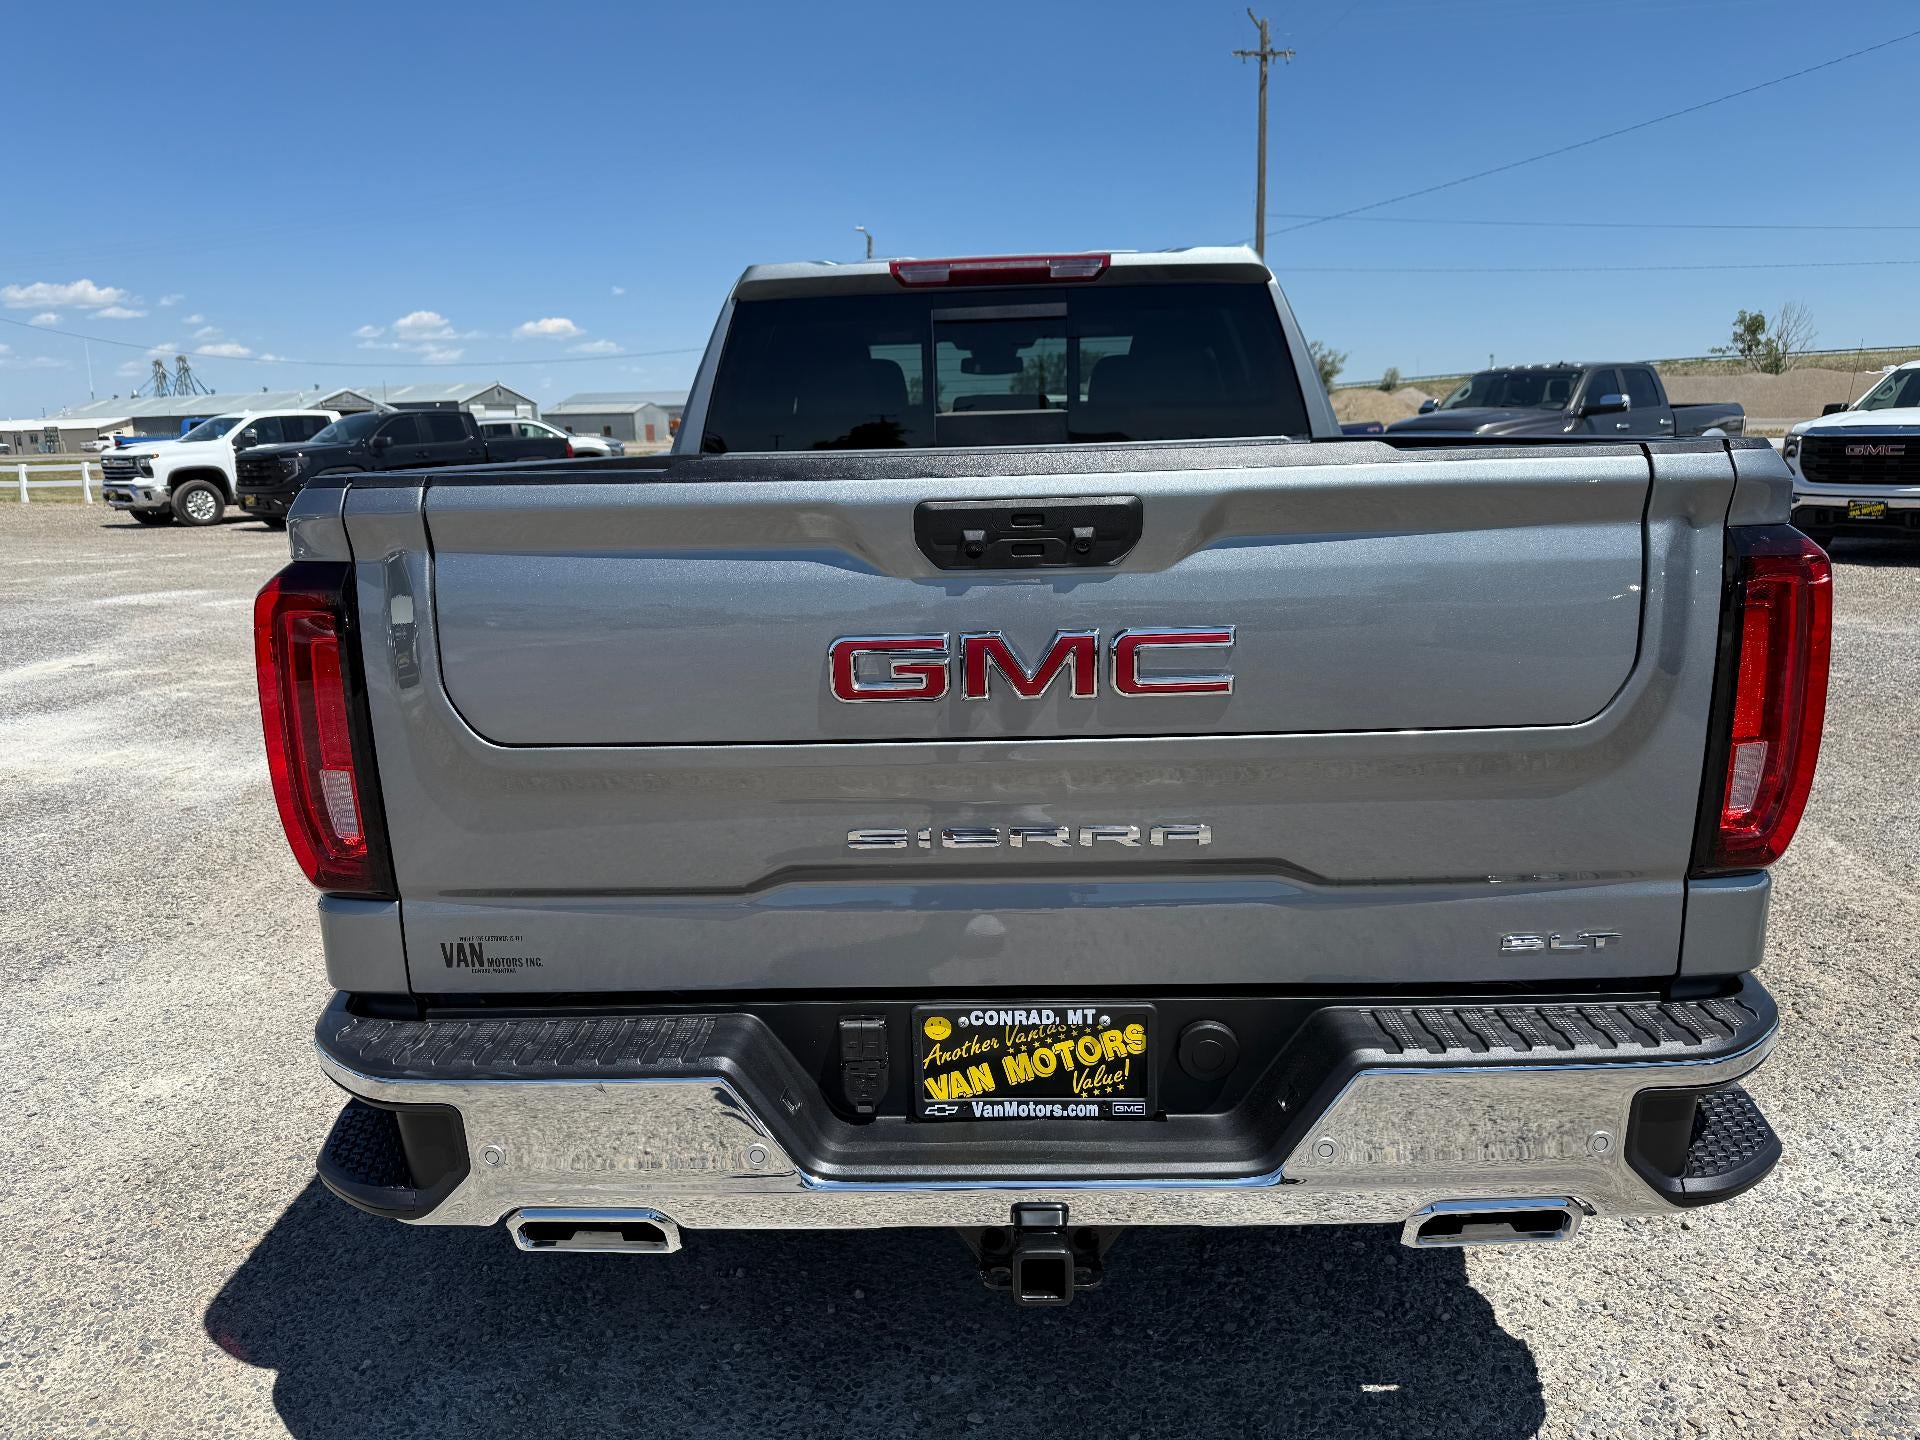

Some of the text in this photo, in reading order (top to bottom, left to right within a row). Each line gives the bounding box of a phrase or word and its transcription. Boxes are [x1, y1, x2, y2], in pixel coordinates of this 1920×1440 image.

[1846, 445, 1905, 455] GMC
[828, 625, 1237, 702] GMC
[847, 824, 1212, 849] SIERRA
[1500, 930, 1623, 951] SLT
[440, 942, 544, 968] VAN MOTORS INC.
[969, 1009, 1096, 1026] CONRAD, MT
[922, 1035, 1000, 1070] Another
[924, 1023, 1147, 1100] VAN MOTORS
[1073, 1058, 1130, 1094] Value!
[971, 1101, 1099, 1118] VanMotors.com
[1115, 1105, 1143, 1113] GMC
